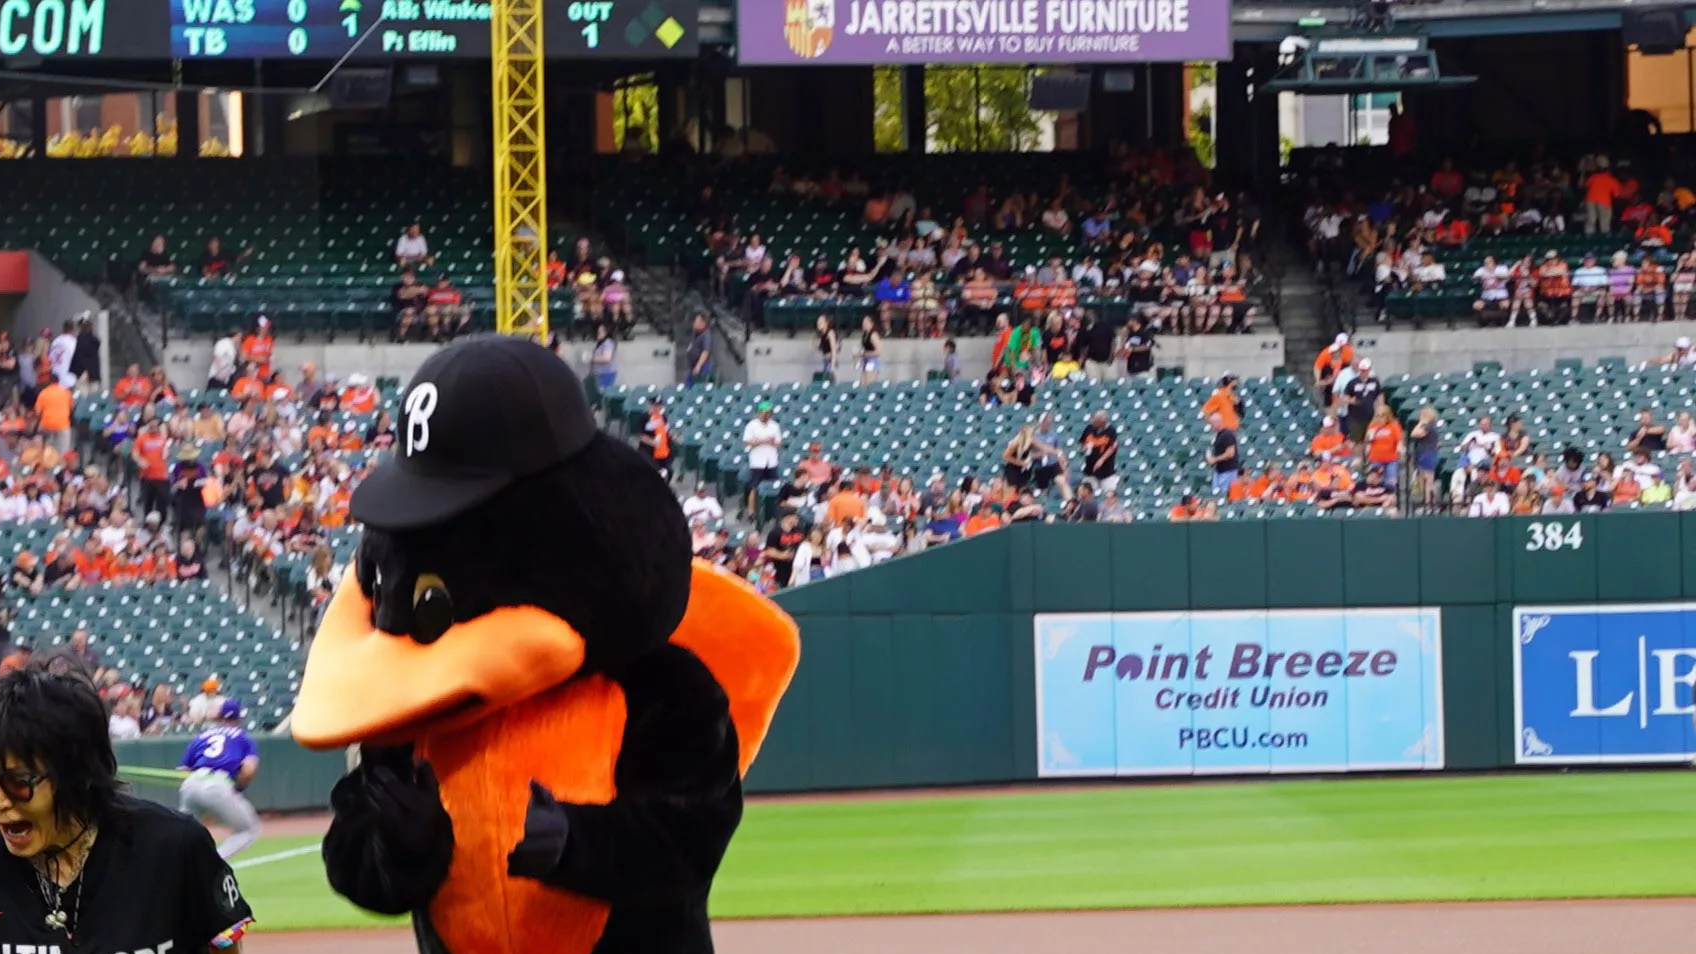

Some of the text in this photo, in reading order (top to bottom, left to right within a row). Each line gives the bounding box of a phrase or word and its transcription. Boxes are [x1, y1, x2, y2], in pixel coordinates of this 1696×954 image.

[180, 0, 307, 24] WAS 0
[423, 0, 492, 20] Winke
[567, 1, 614, 21] OUT
[844, 0, 1189, 35] JARRETTSVILLE FURNITURE
[341, 13, 358, 38] 1
[580, 22, 600, 48] 1
[182, 27, 308, 56] TB 0
[902, 35, 954, 54] BETTER
[955, 35, 995, 54] WAY
[996, 36, 1023, 54] TO
[1023, 35, 1058, 53] BUY
[1057, 34, 1140, 53] FURNITURE
[405, 381, 439, 458] B
[1525, 520, 1584, 551] 384
[1082, 642, 1398, 683] Point Breeze
[1154, 684, 1329, 711] Credit Union
[203, 735, 227, 759] 3
[1178, 726, 1309, 750] PBCU.com
